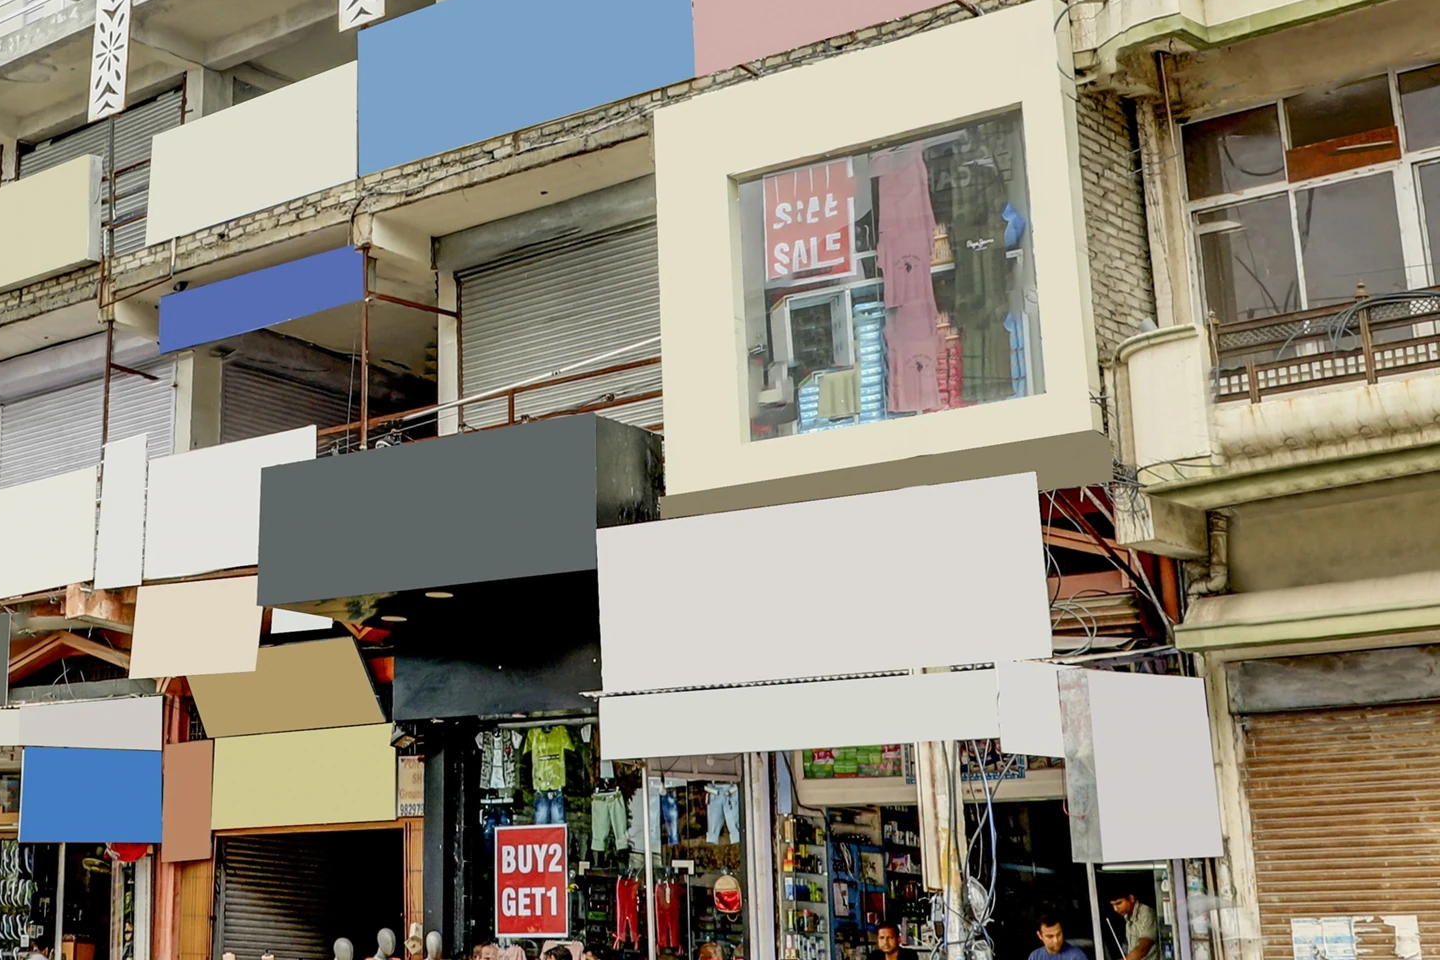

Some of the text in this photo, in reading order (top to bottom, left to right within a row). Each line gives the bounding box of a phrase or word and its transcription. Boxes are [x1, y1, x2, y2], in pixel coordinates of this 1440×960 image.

[774, 232, 845, 275] SALE
[502, 843, 562, 874] BUY2
[502, 887, 558, 917] GET1
